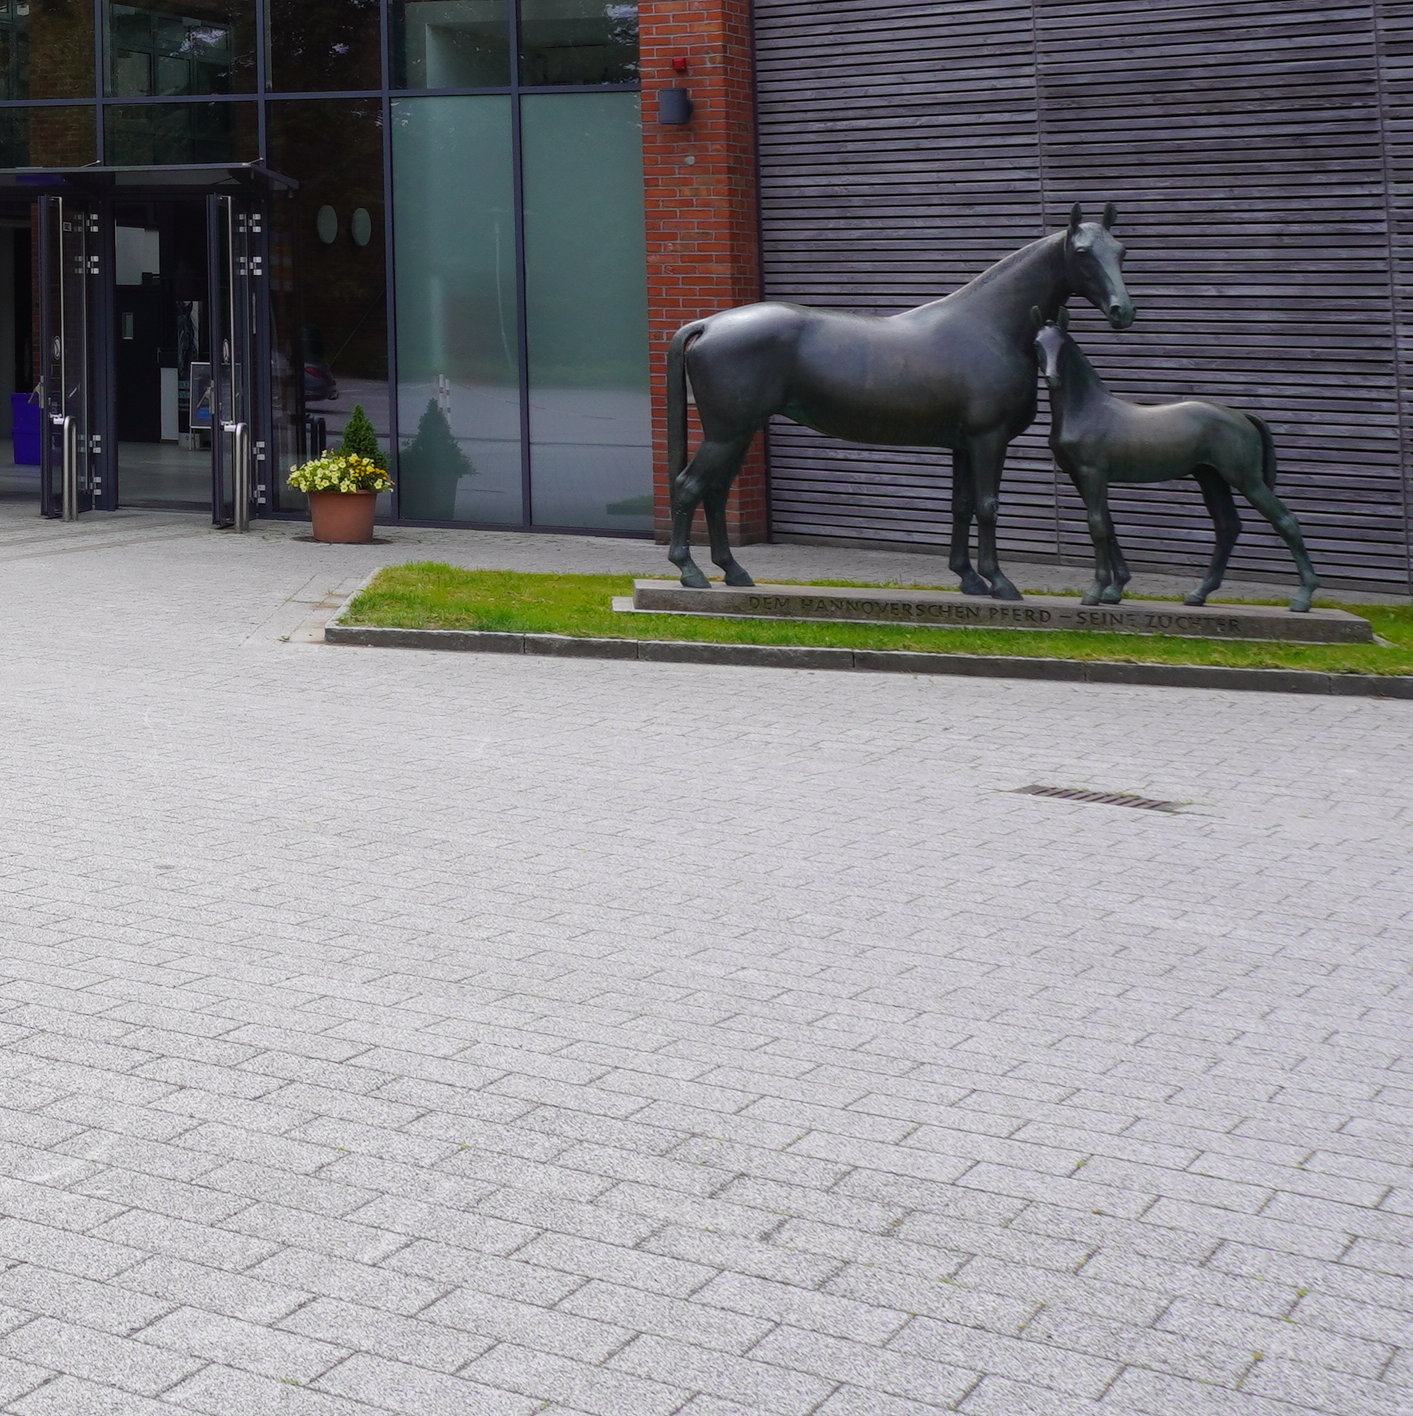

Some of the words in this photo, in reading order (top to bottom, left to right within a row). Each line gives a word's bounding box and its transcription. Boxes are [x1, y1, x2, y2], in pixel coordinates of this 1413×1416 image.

[748, 595, 791, 610] DEM
[801, 598, 980, 620] HANNOVERSCHEN
[989, 607, 1052, 623] PFERD
[1076, 611, 1136, 627] SEINE
